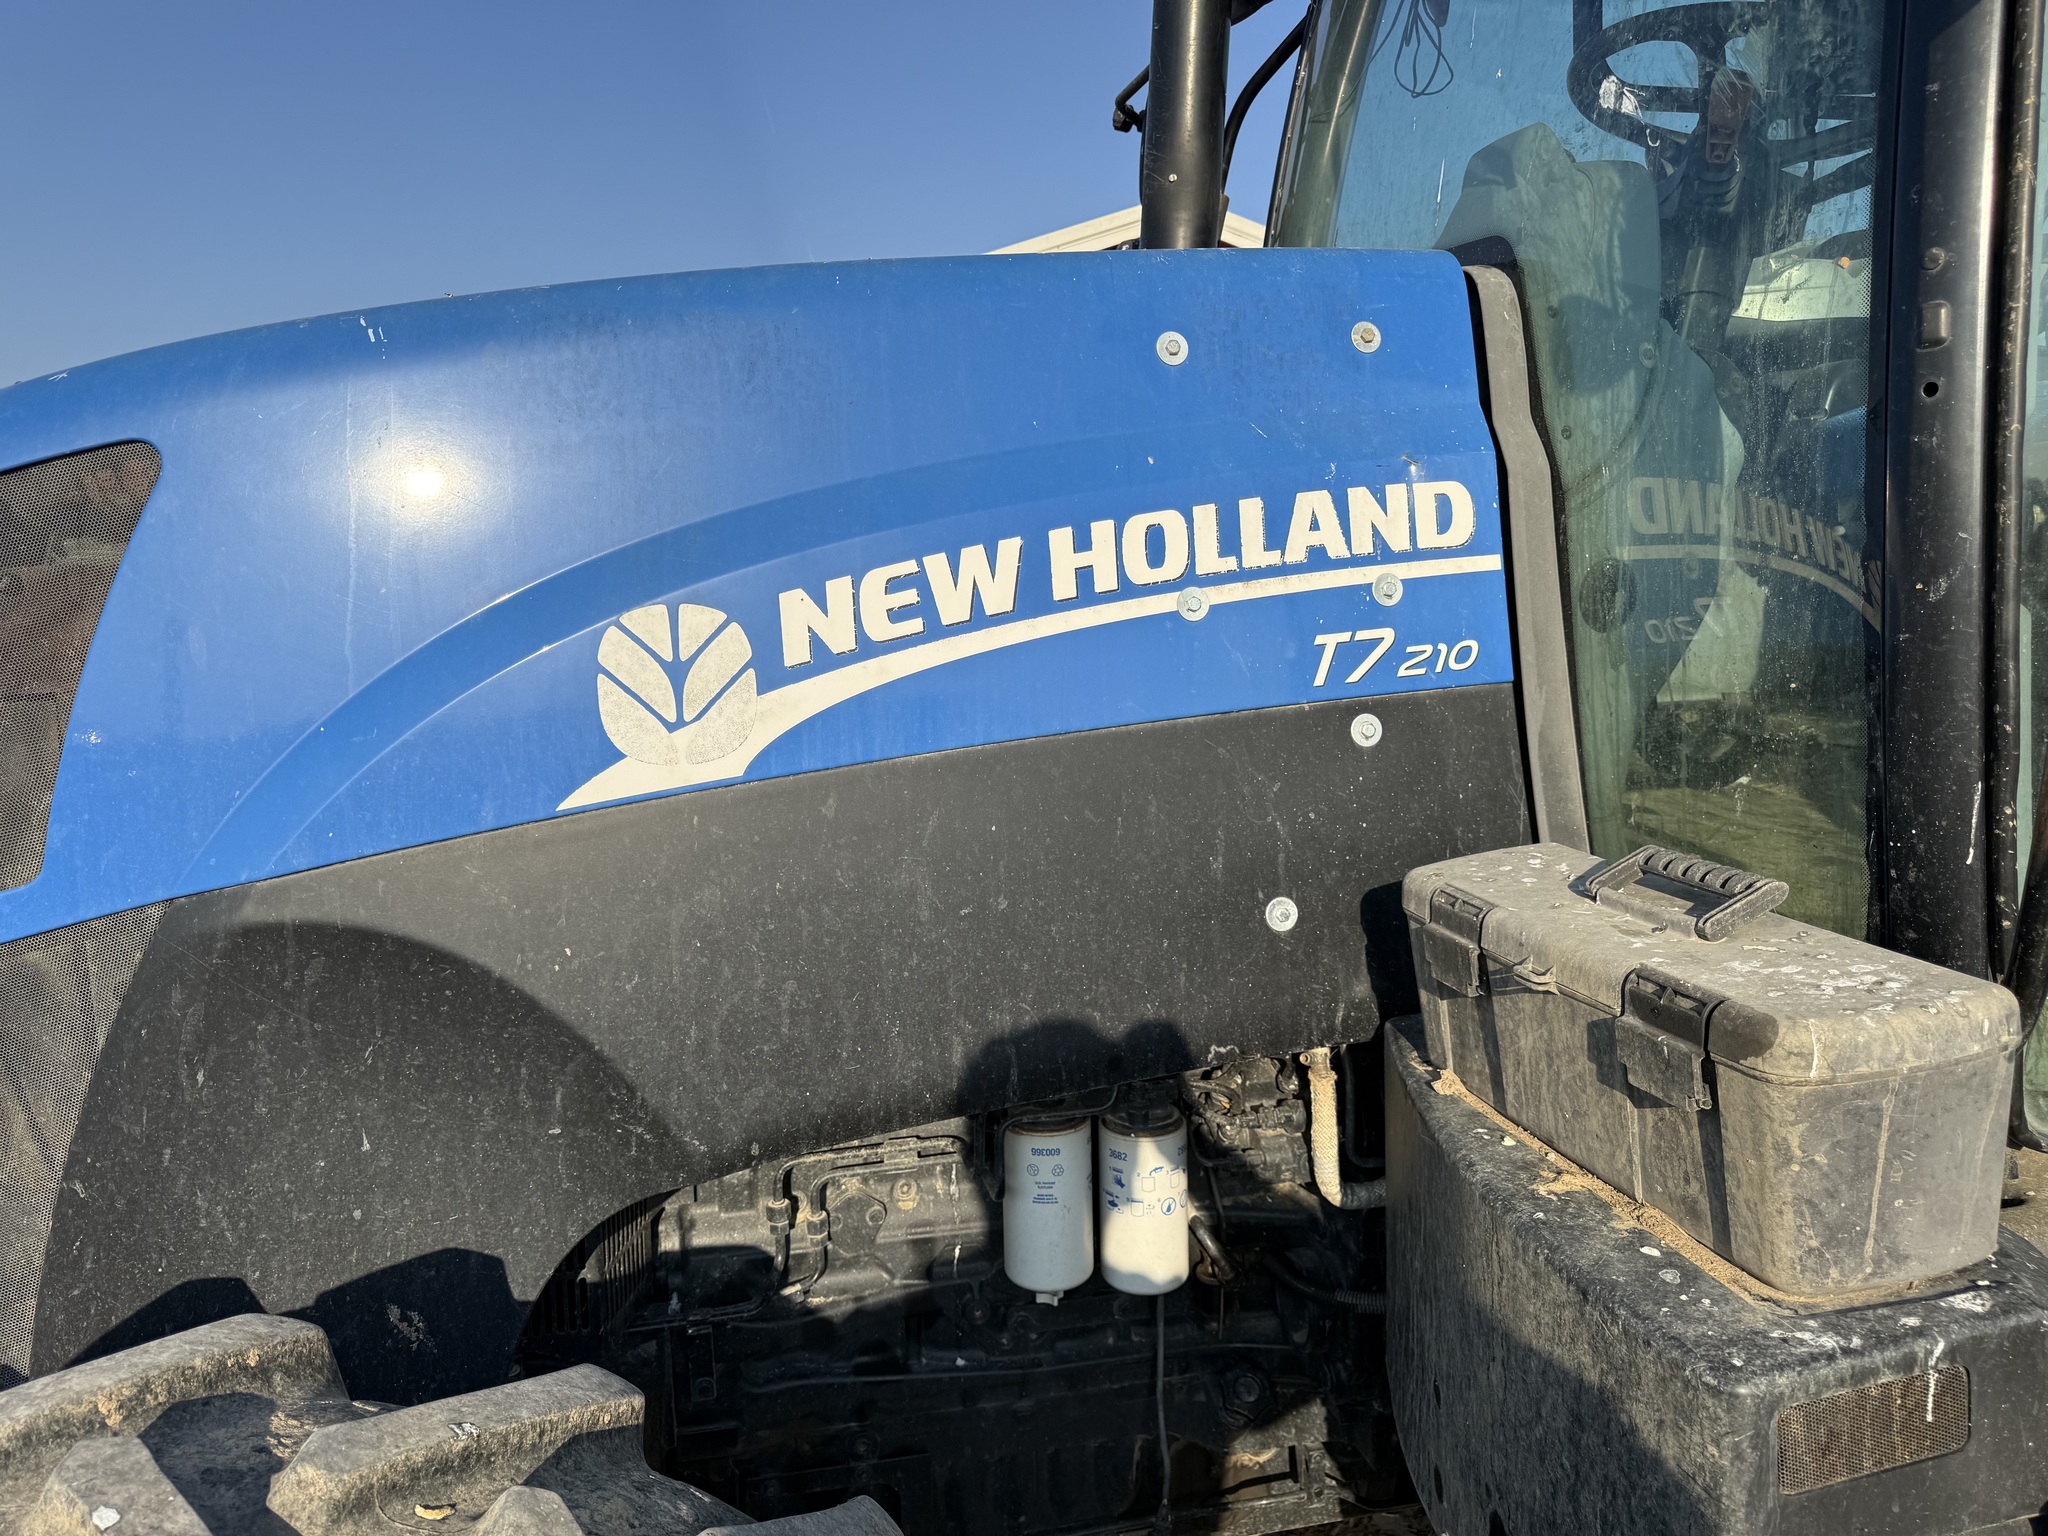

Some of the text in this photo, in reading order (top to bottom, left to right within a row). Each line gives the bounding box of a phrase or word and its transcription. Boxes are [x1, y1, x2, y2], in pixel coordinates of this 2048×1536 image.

[779, 480, 1476, 669] NEW HOLLAND
[1313, 626, 1479, 687] T7 210
